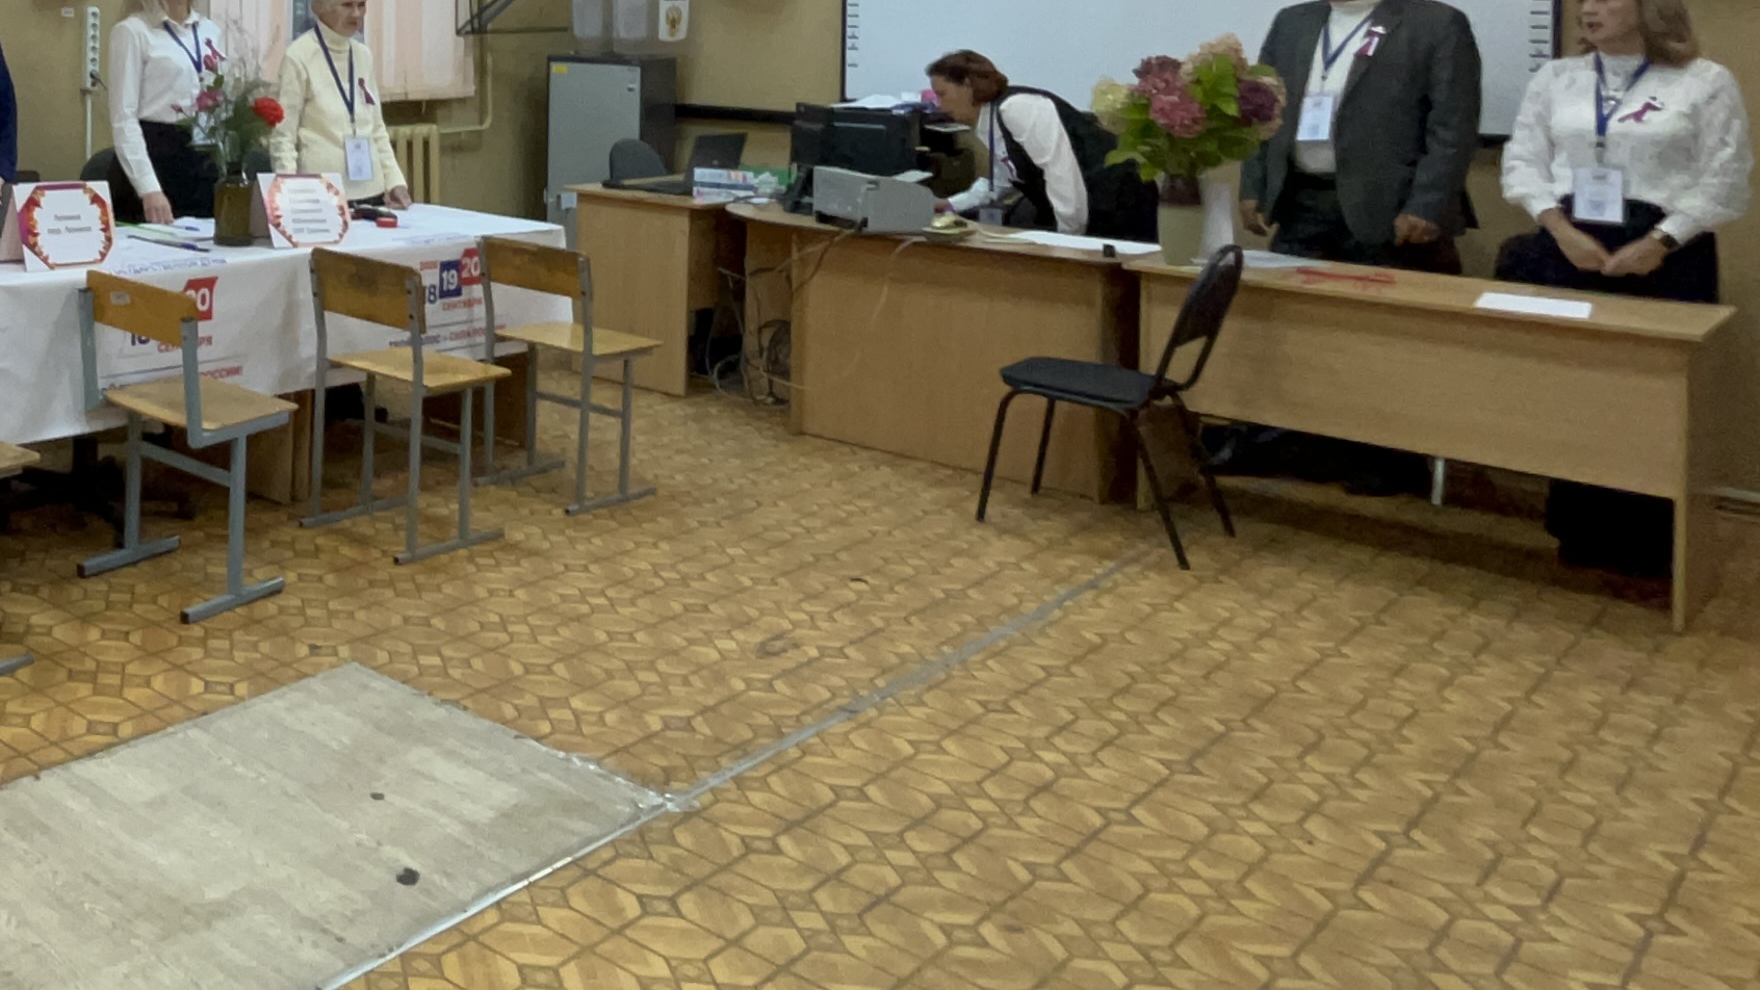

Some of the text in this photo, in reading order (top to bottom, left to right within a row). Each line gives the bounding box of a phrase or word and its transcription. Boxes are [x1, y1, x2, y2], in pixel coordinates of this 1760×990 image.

[427, 283, 438, 305] 8
[442, 269, 459, 291] 19
[462, 256, 480, 278] 20
